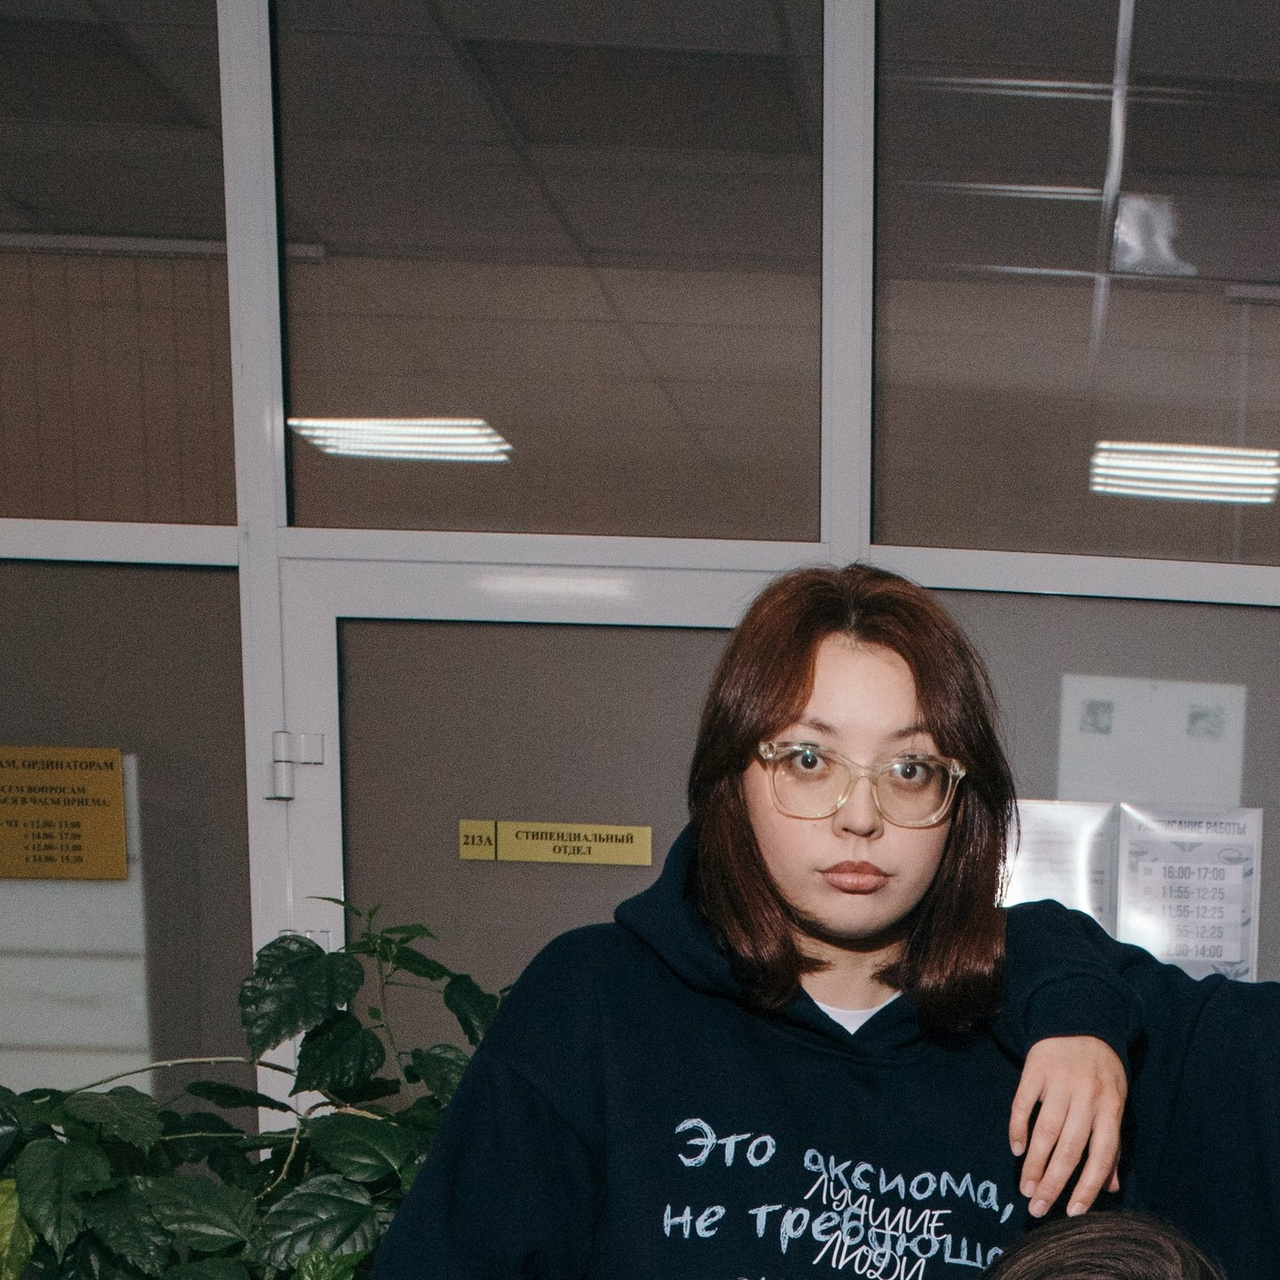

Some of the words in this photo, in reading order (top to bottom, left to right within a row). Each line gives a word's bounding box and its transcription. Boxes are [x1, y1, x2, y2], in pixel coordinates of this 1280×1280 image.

[22, 761, 114, 771] ОРДИНАТОРАМ
[1206, 821, 1246, 836] РАБОТЫ
[515, 830, 634, 844] СТИПЕНДИАЛЬНЫЙ
[552, 845, 592, 855] ОТДЕЛ
[675, 1118, 776, 1167] Это
[804, 1148, 1014, 1224] аксиома,
[804, 1174, 952, 1239] ЛУЧШИЕ
[663, 1204, 726, 1239] не
